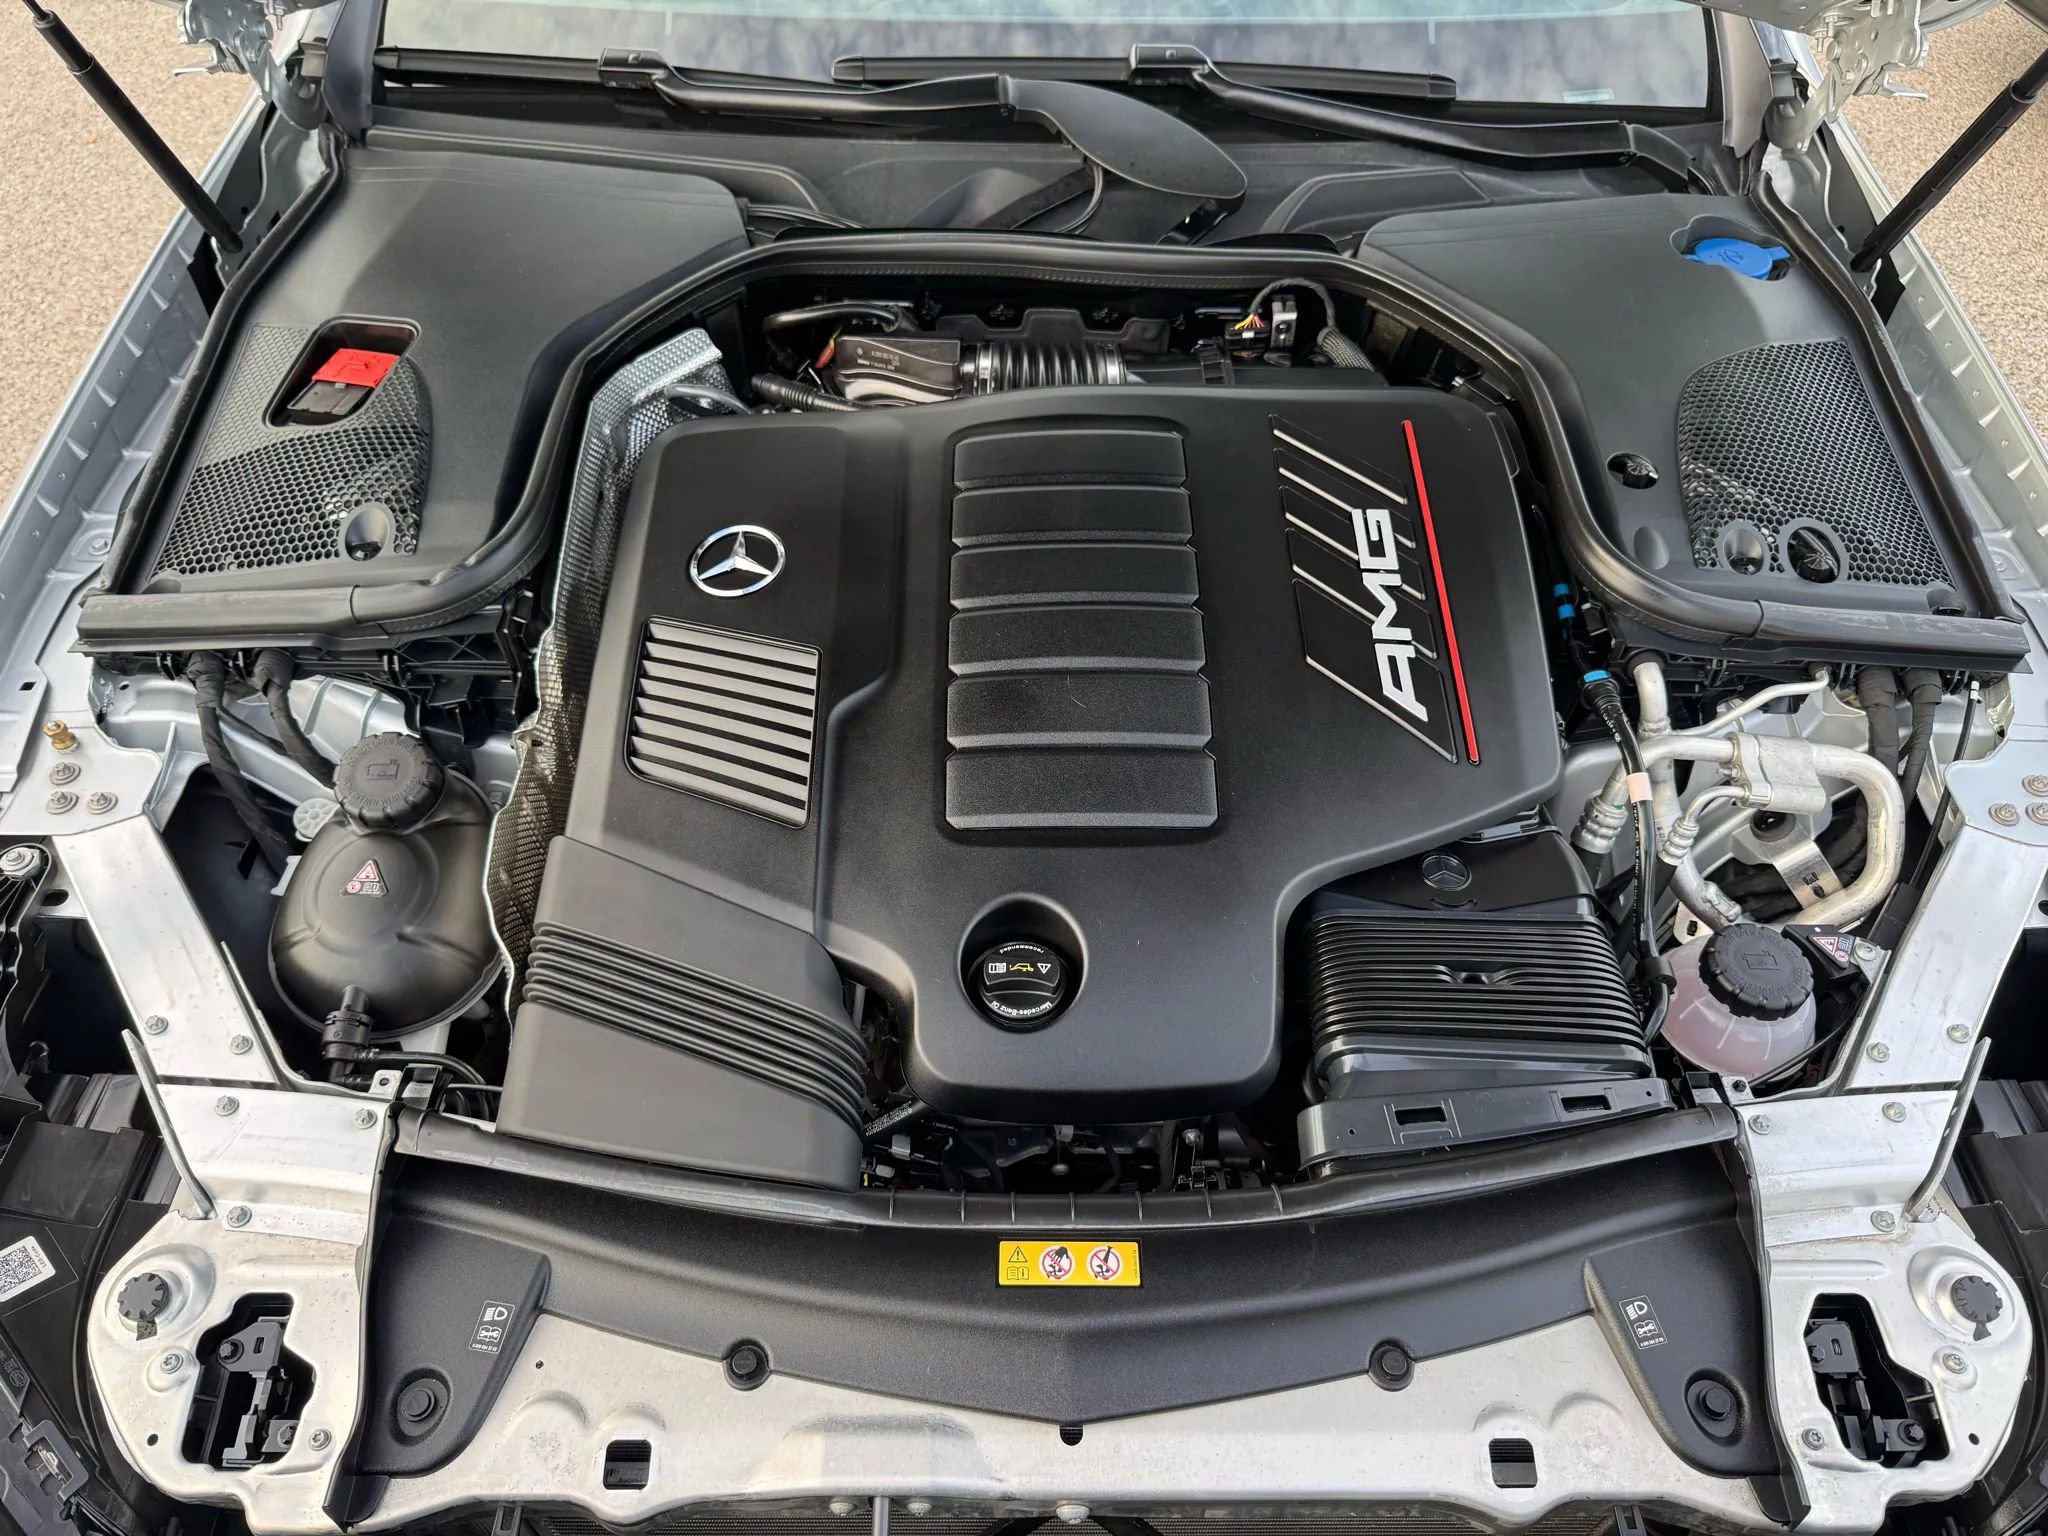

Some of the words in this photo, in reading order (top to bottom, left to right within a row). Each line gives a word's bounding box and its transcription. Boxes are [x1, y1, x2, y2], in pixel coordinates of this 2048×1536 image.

[1352, 509, 1428, 722] AMG
[1000, 944, 1045, 954] recommended
[1000, 1001, 1053, 1016] Mercedes-Benz
